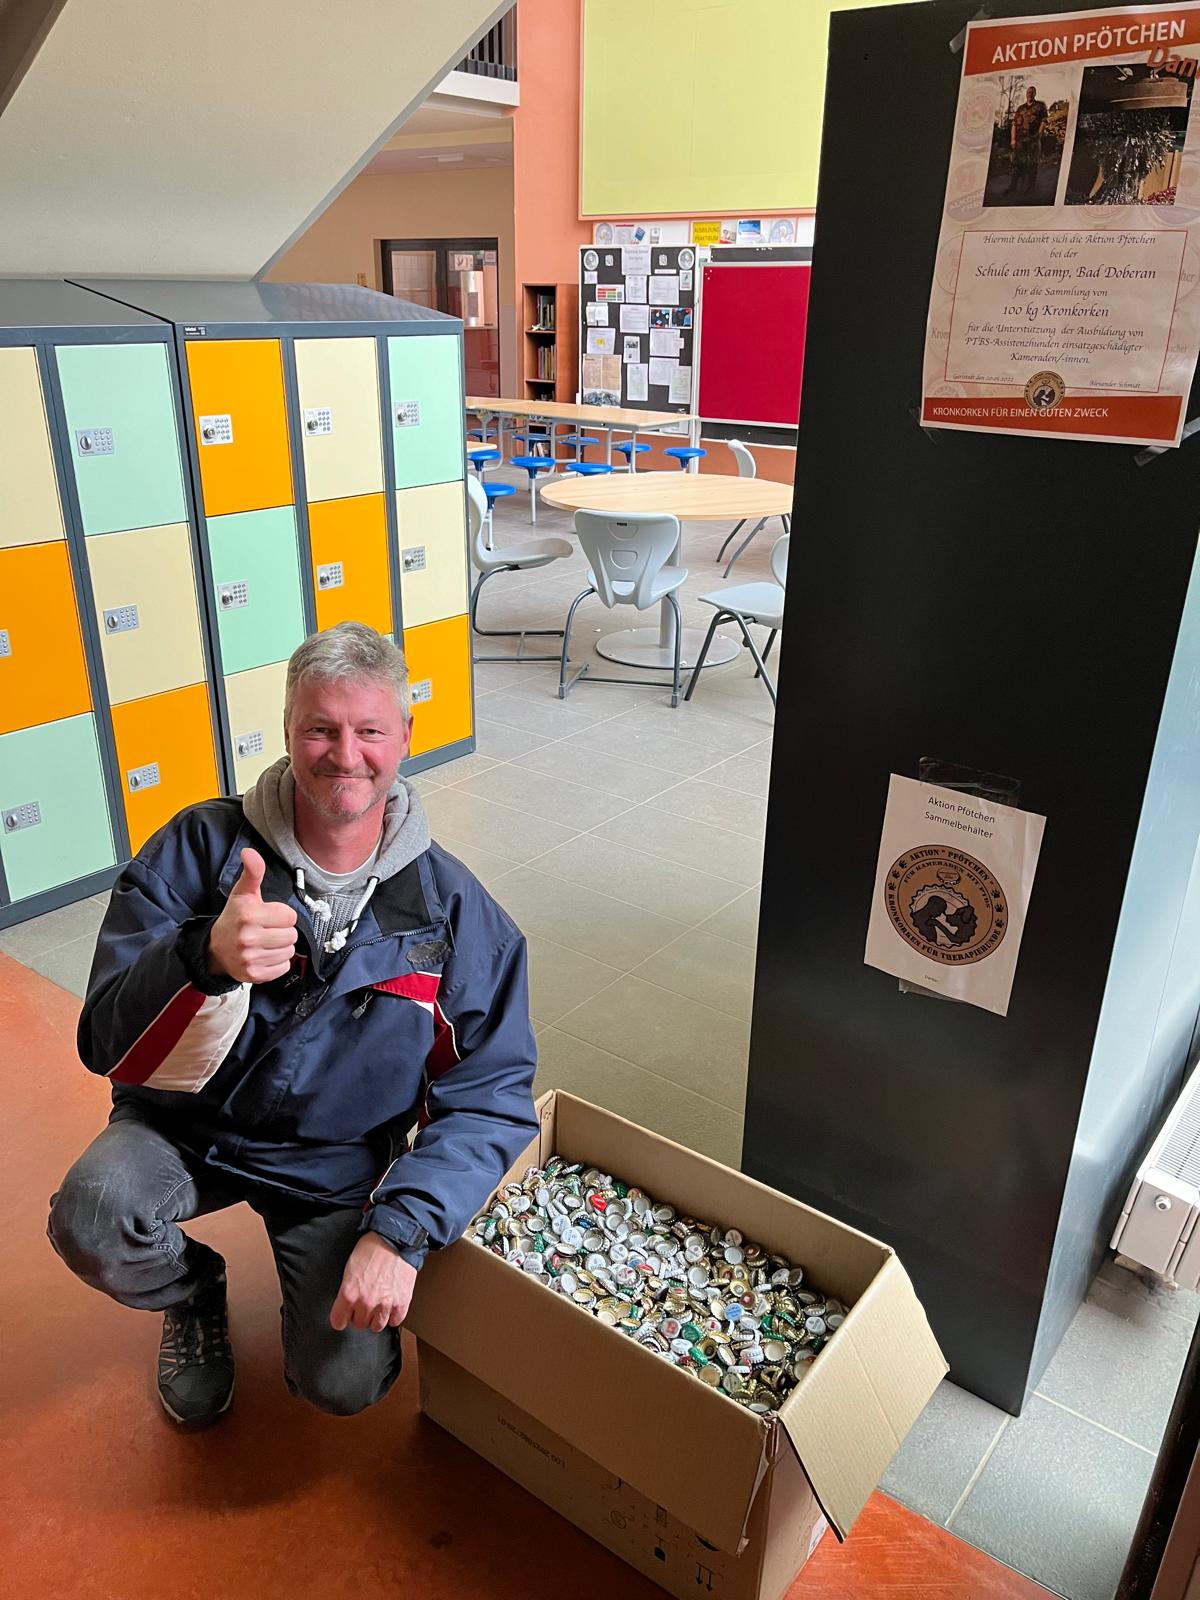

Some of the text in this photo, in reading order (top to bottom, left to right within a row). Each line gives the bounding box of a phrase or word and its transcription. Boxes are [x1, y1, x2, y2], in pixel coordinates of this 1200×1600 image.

[992, 19, 1186, 64] AKTION PFÖTCHEN
[1147, 45, 1200, 80] Dan
[983, 233, 1156, 247] Hiermit bedankt sich die Aktion Pfötchen
[1050, 248, 1078, 258] bei der
[976, 262, 1156, 282] Schule am Kamp, Bad Doberan
[1014, 286, 1108, 300] für die Sammlung von
[1002, 301, 1109, 321] 100 kg Kronkorken
[966, 323, 1144, 339] für die Unterstützung der Ausbildung von
[964, 337, 1144, 355] PTBS-Assistenzhunden einsatzgeschädigter
[1010, 352, 1090, 365] Kameraden/-innen.
[933, 407, 1109, 418] KRONKORKEN FÜR EINEN GUTEN ZWECK
[928, 797, 995, 823] Aktion Pfötchen
[925, 812, 993, 839] Sammelbehälter
[910, 849, 939, 862] AKTION
[940, 929, 1001, 961] THERAPIEHUNDE
